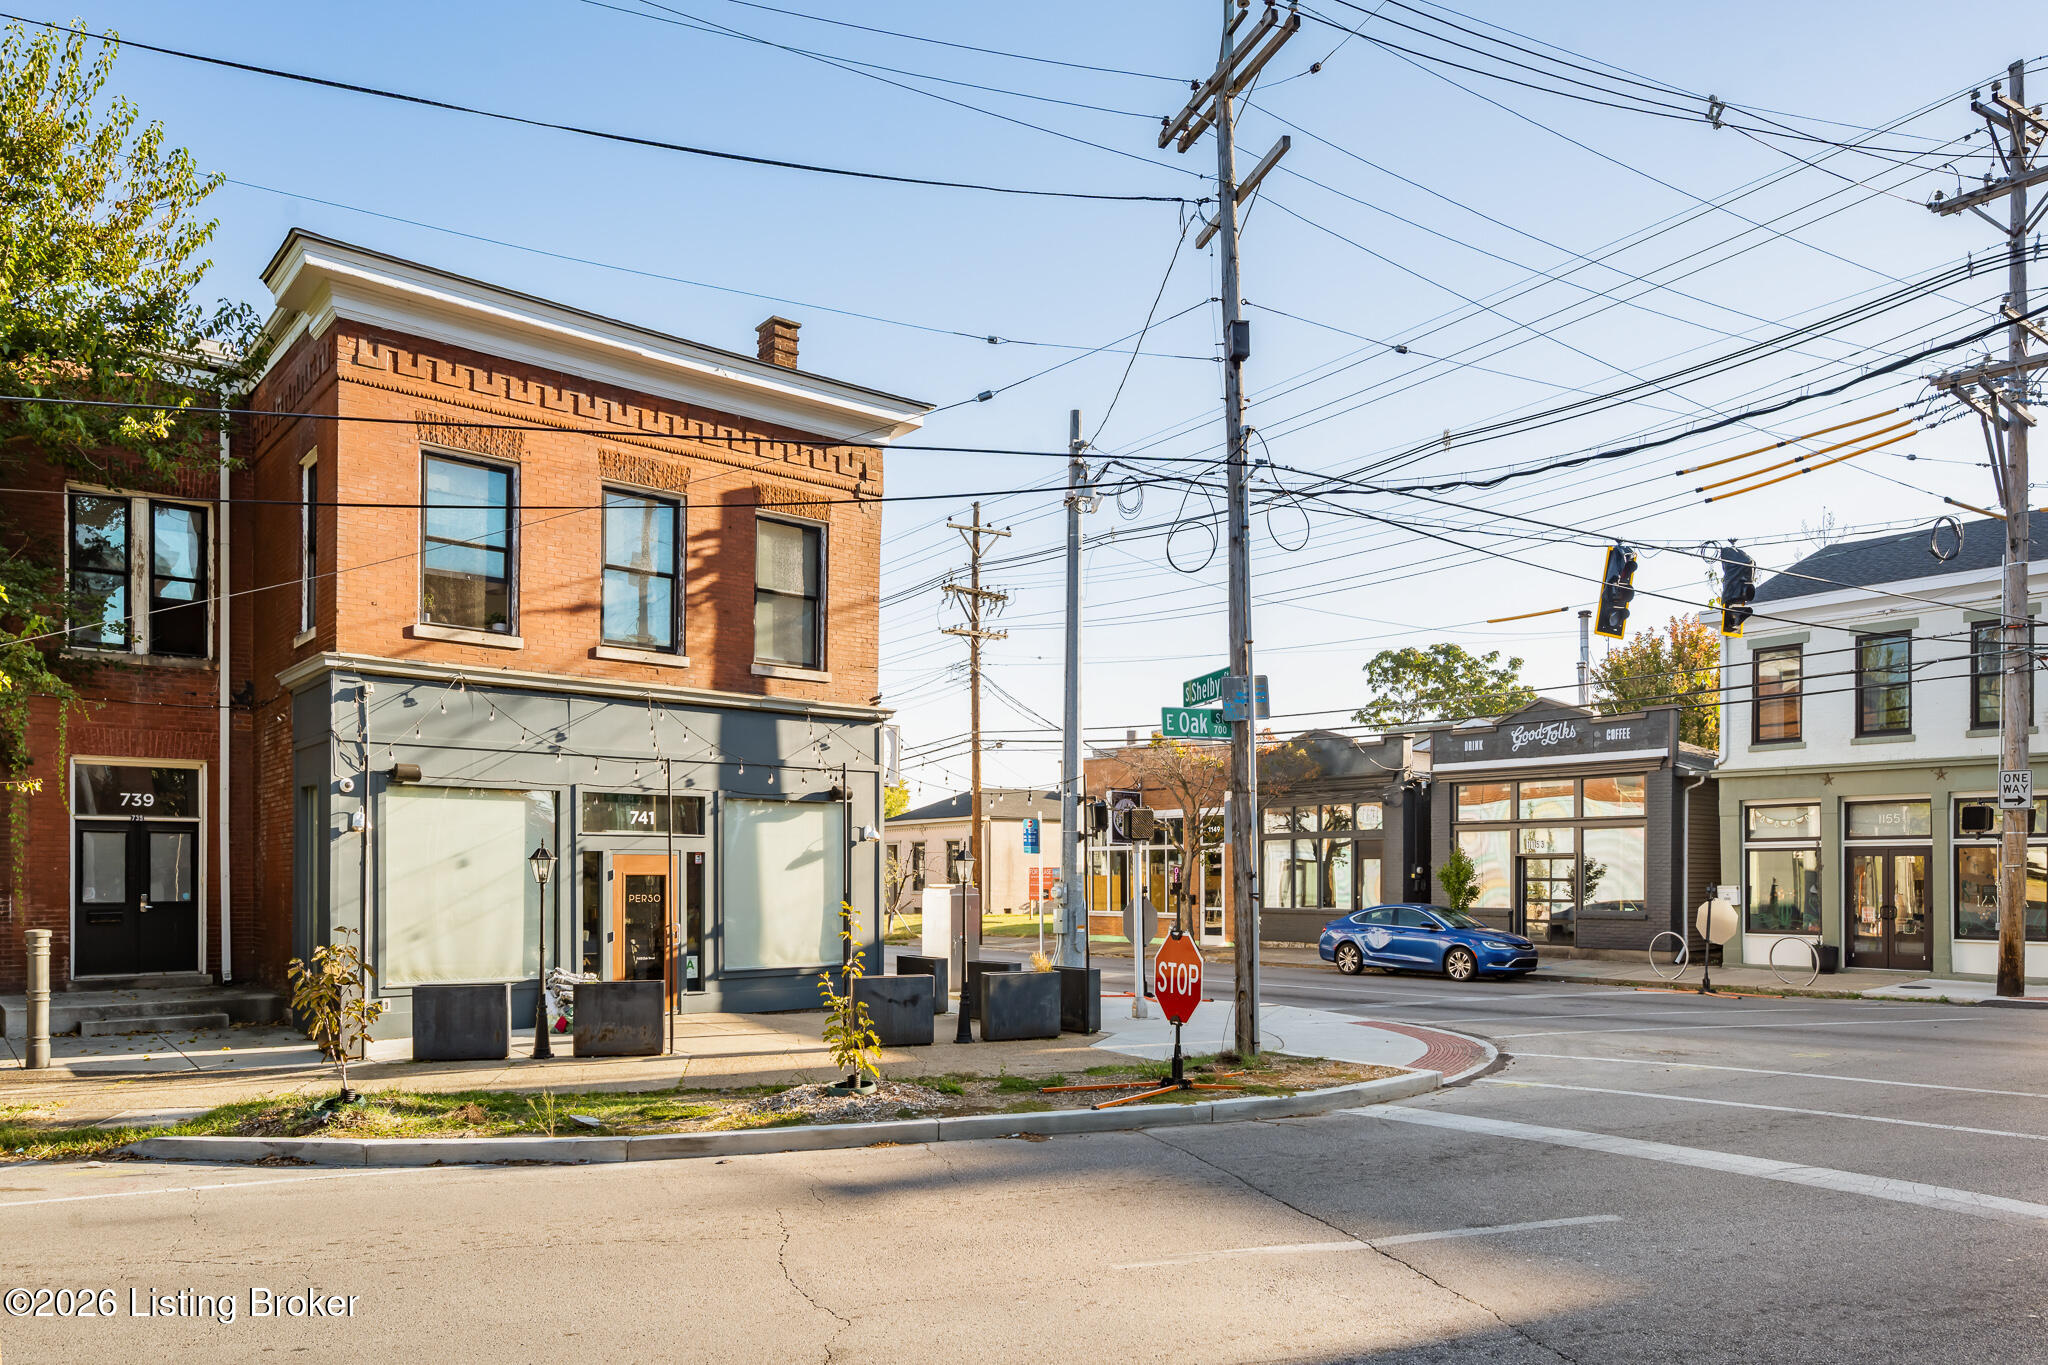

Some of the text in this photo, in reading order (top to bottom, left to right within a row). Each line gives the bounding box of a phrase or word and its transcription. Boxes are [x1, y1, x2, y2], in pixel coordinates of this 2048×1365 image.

[1185, 687, 1190, 702] S
[1191, 678, 1221, 702] Shelby
[1166, 714, 1174, 730] E
[1179, 712, 1208, 734] Oak
[1213, 725, 1228, 735] 700
[1606, 727, 1631, 741] COFFEE
[1464, 740, 1483, 752] DRINK
[2003, 773, 2028, 783] ONE
[2003, 784, 2029, 794] WAY
[120, 793, 154, 807] 739
[630, 810, 655, 825] 741
[1879, 813, 1900, 824] 1155
[628, 894, 661, 903] PERSO
[686, 959, 695, 970] A
[1157, 961, 1199, 996] STOP
